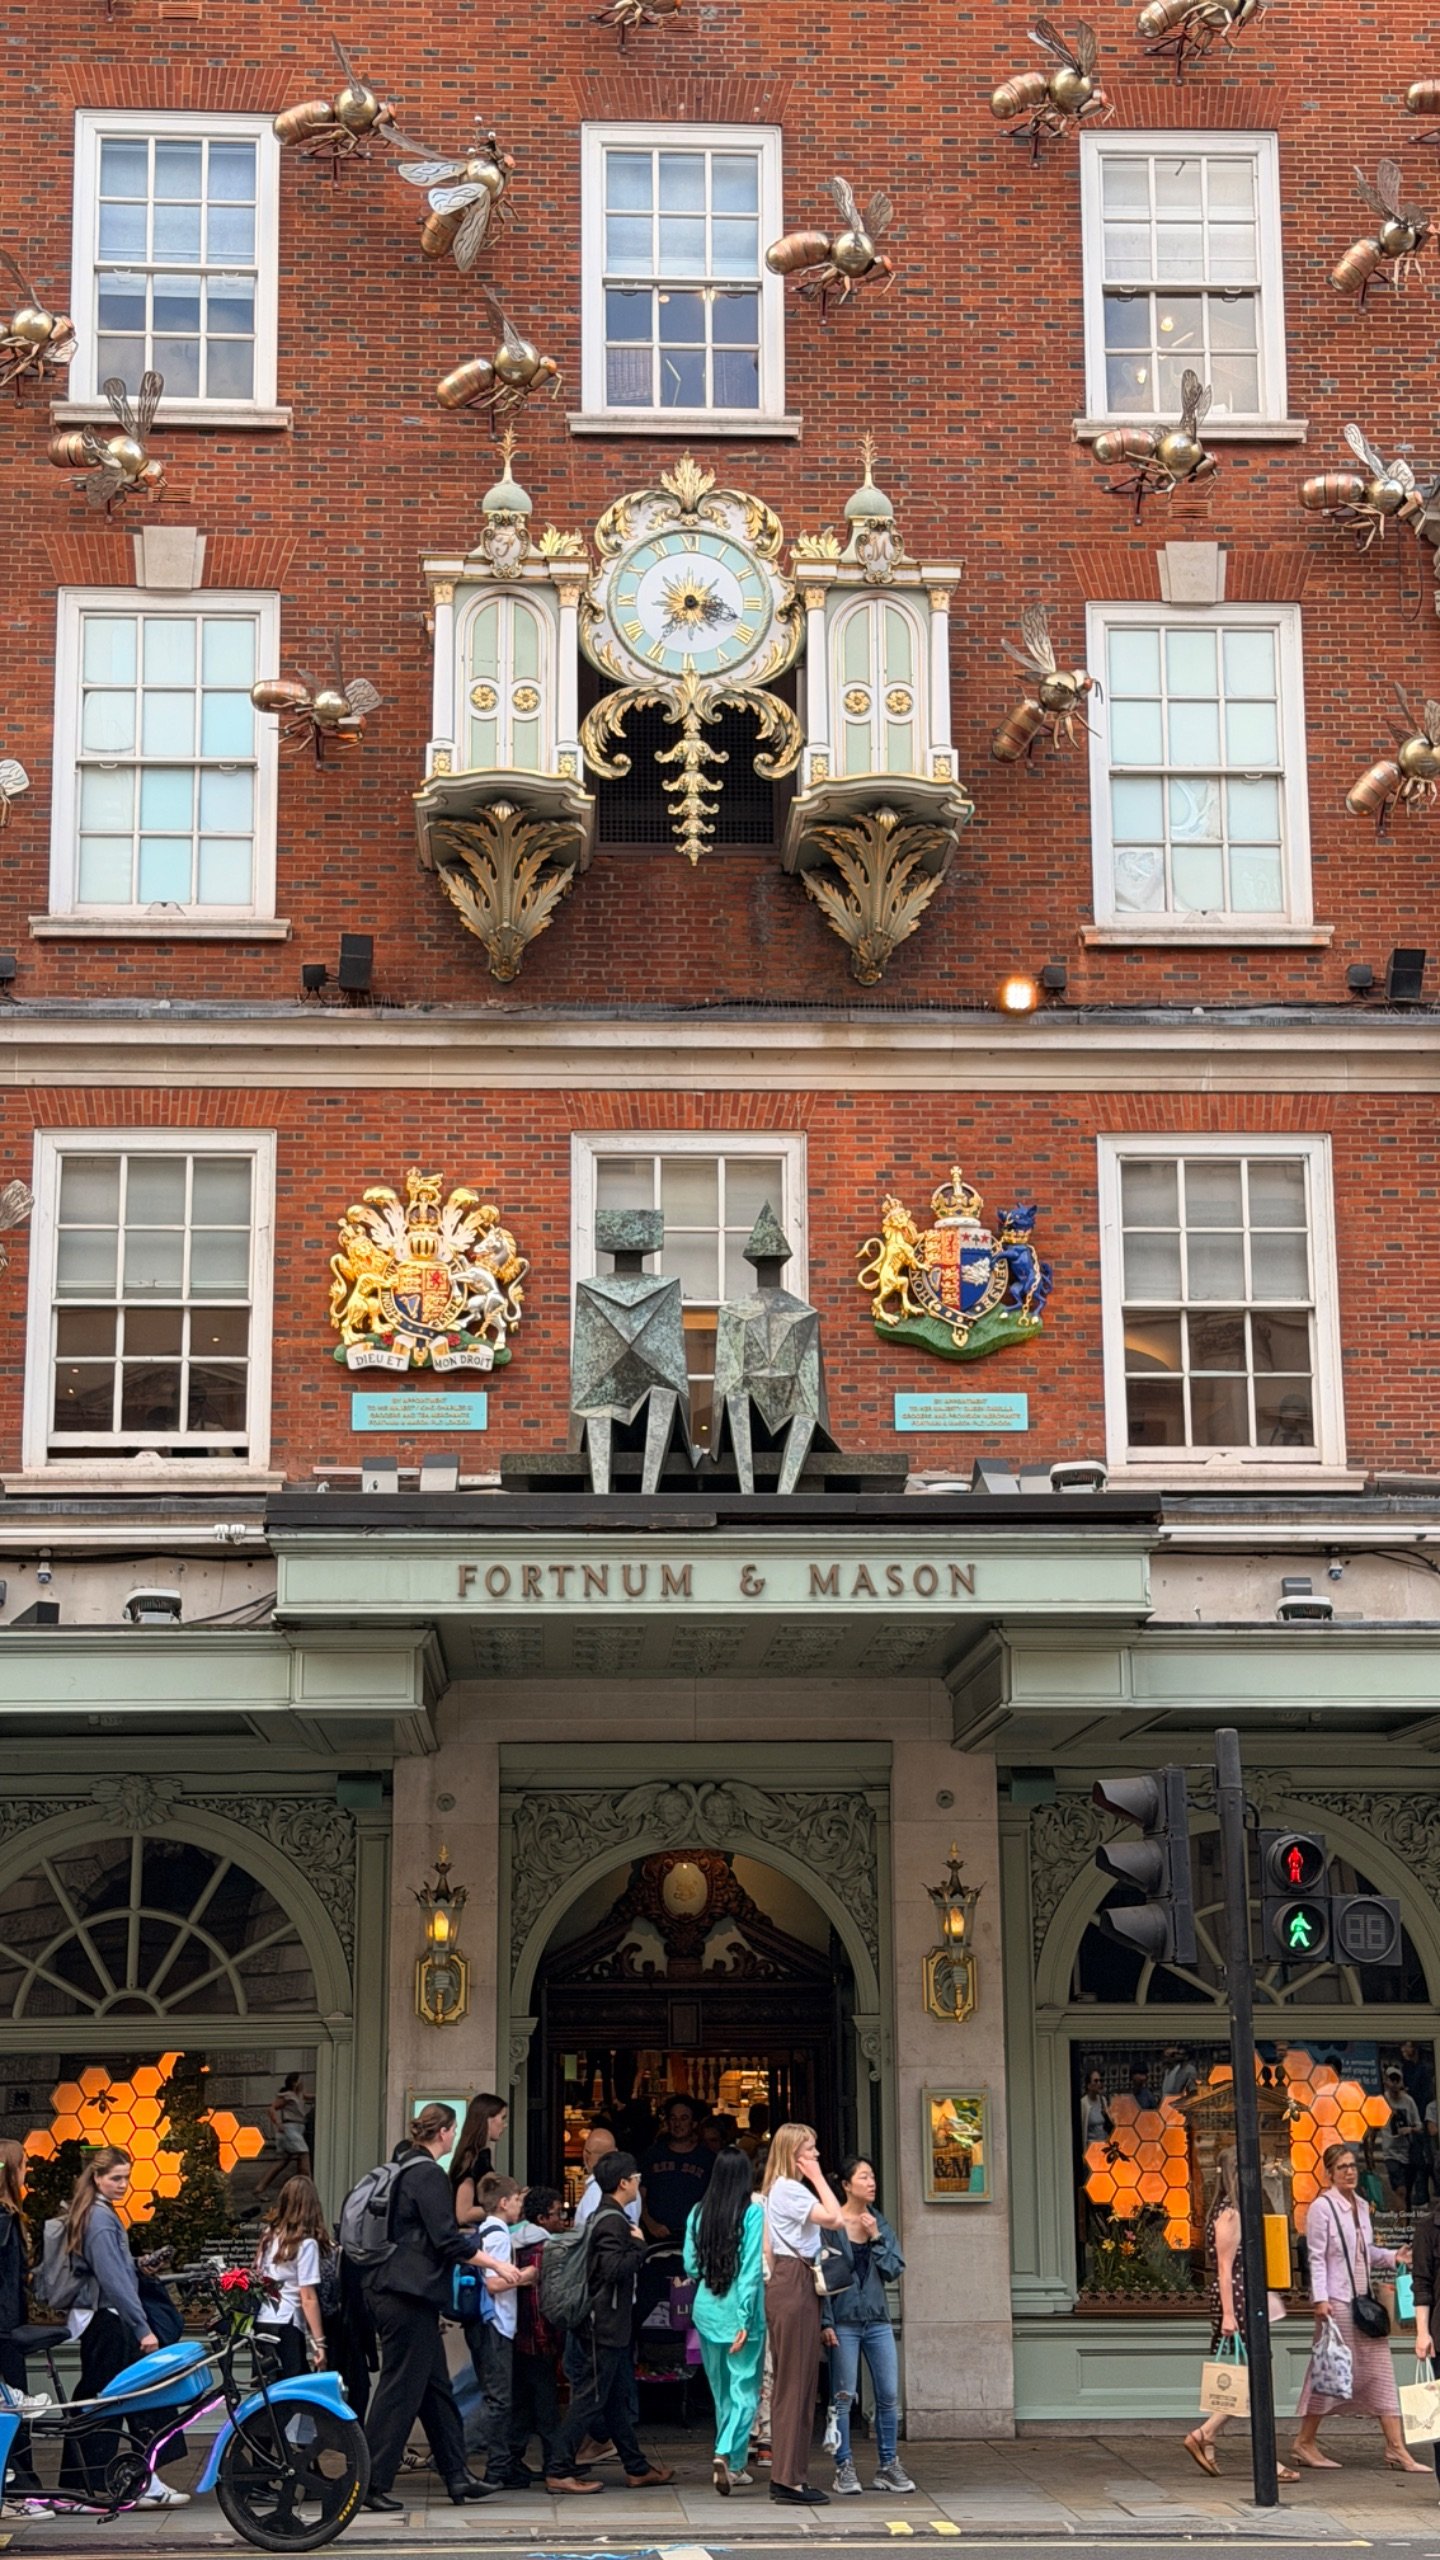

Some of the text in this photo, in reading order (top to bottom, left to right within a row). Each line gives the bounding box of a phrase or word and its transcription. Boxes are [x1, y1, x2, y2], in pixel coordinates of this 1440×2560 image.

[355, 1353, 404, 1367] DIEU ET
[434, 1353, 492, 1369] MON DROIT
[457, 1563, 977, 1598] FORTNUM & MASON
[932, 2155, 971, 2179] &M
